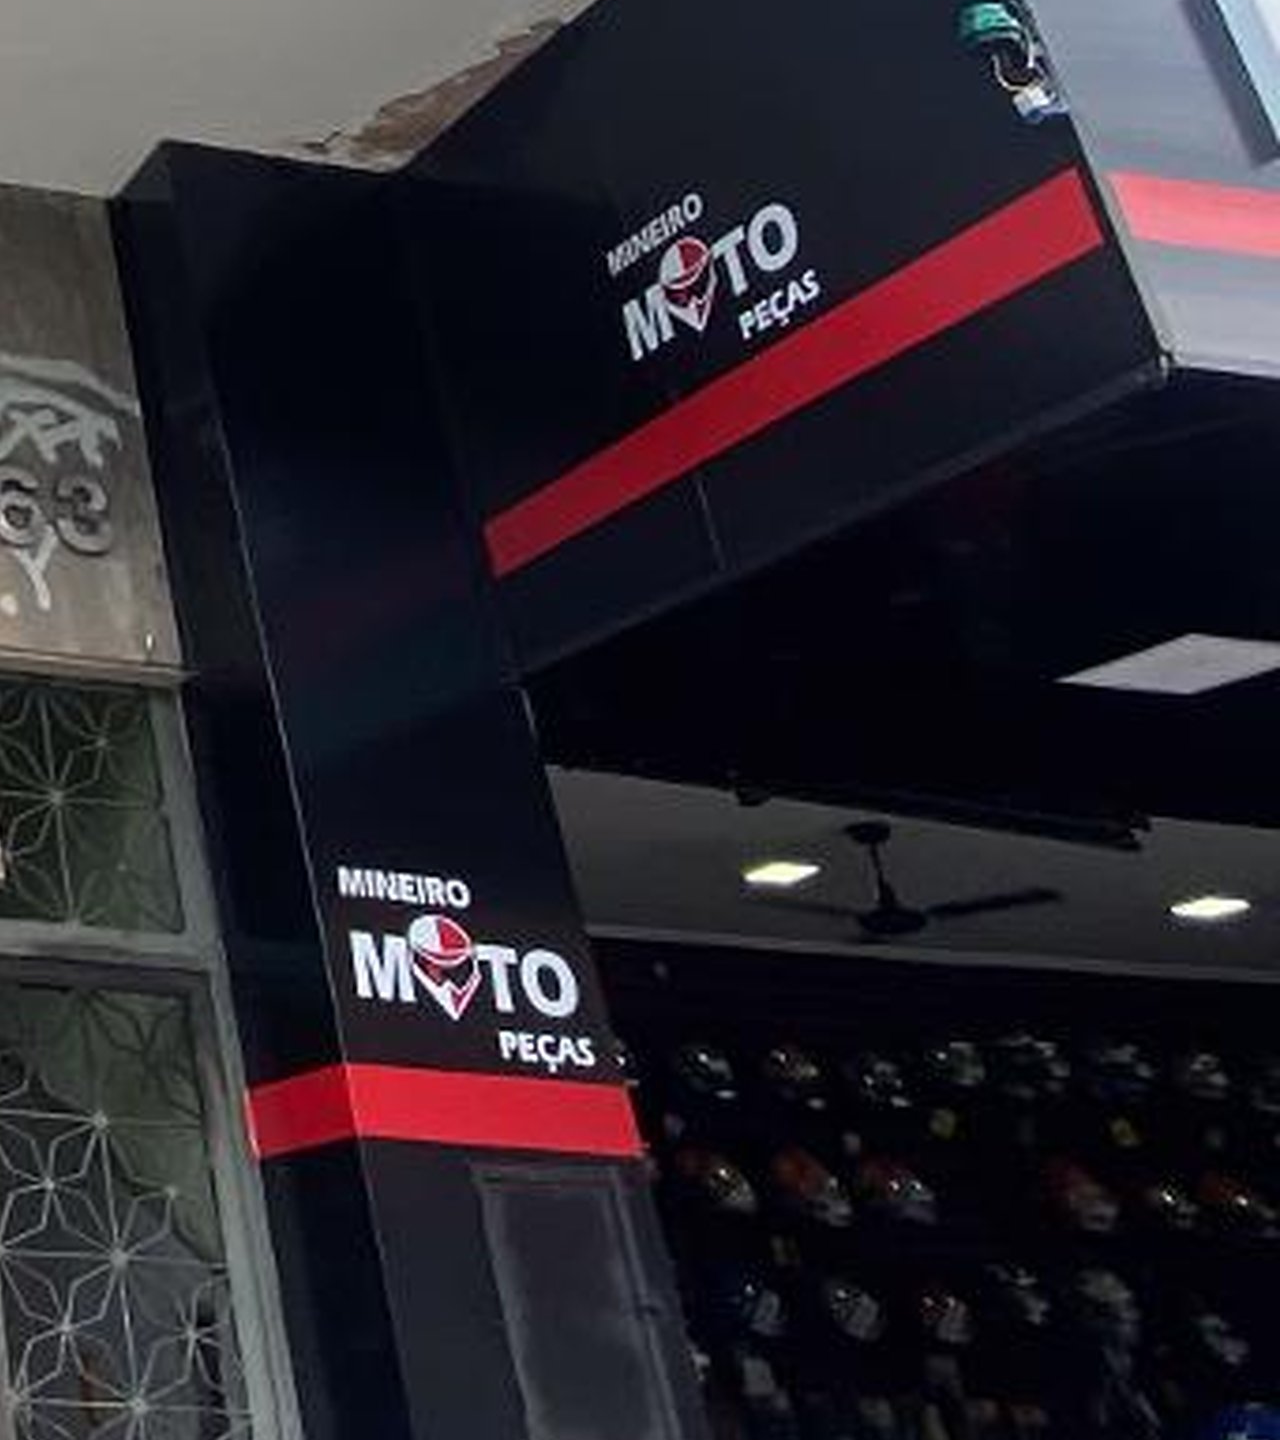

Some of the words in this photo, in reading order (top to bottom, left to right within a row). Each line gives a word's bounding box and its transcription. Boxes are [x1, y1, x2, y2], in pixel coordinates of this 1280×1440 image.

[606, 193, 703, 277] MINEIRO
[739, 269, 821, 340] PEÇAS
[338, 866, 471, 909] MINEIRO
[498, 1030, 596, 1073] PEÇAS
